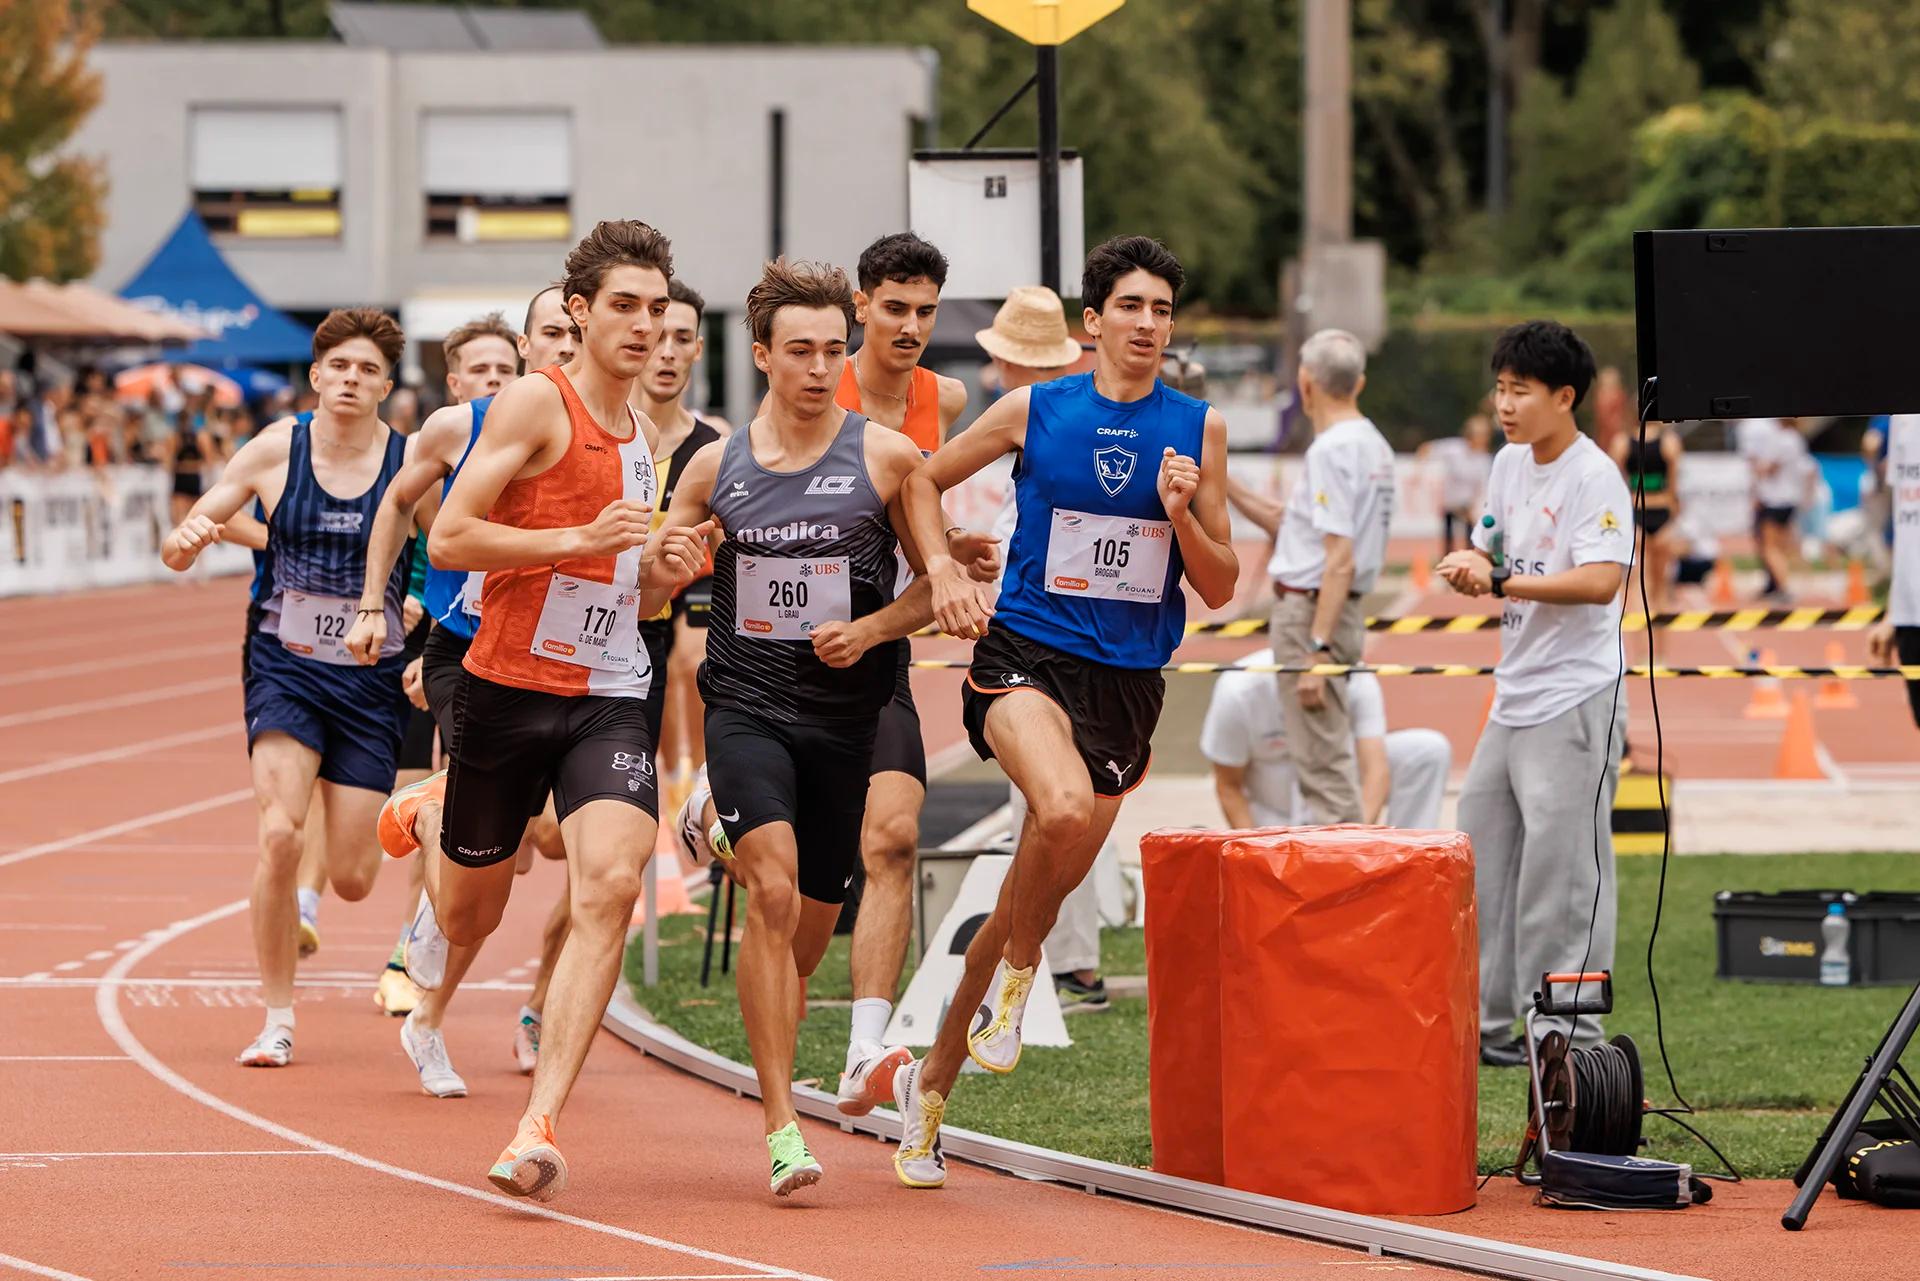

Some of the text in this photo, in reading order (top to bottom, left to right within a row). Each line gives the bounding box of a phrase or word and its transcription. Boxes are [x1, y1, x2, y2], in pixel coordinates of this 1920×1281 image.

[1096, 428, 1130, 437] CRAFT
[585, 444, 604, 452] CRAFT
[804, 476, 857, 495] LCZ
[730, 490, 749, 498] erima
[736, 521, 839, 543] medica
[1142, 527, 1165, 538] UBS
[1093, 538, 1130, 568] 105
[815, 563, 840, 575] UBS
[1095, 568, 1120, 579] BROGGINI
[768, 580, 808, 608] 260
[1125, 586, 1155, 594] EQUANS
[784, 609, 799, 619] GRAU
[314, 614, 345, 638] 122
[583, 605, 616, 637] 170
[585, 635, 592, 645] DE
[607, 655, 628, 663] EQUANS
[457, 846, 493, 857] CRAFT
